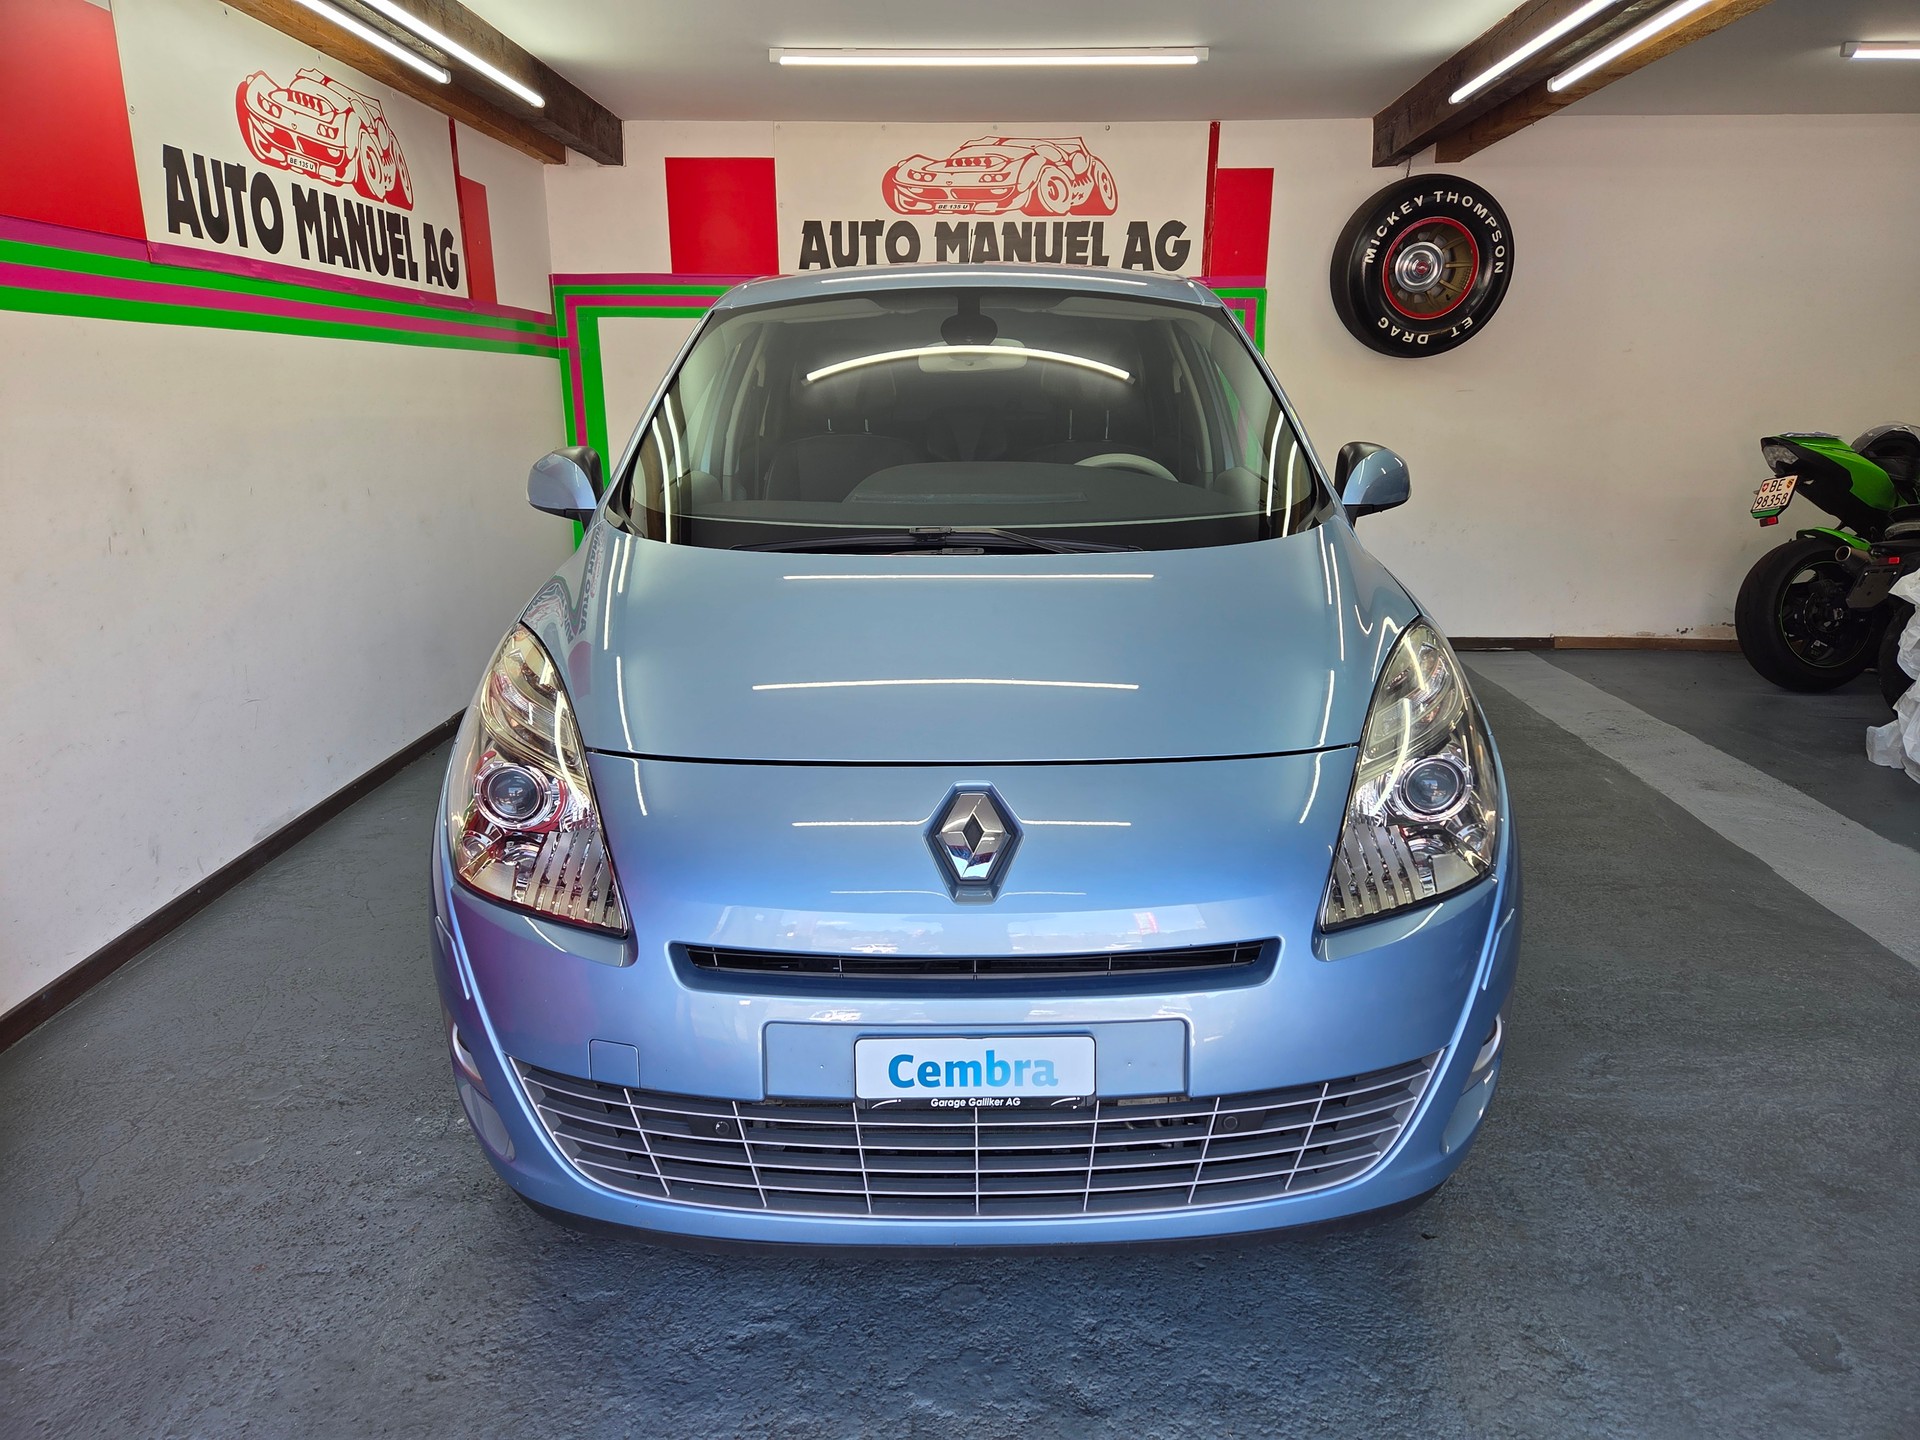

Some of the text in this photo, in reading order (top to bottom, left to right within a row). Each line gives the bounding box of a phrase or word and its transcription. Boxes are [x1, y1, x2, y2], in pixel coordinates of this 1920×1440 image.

[162, 144, 460, 290] AUTO MANUEL AG
[1364, 190, 1505, 274] MICKEY THOMPSON
[799, 219, 1191, 271] AUTO MANUEL AG
[1378, 317, 1429, 344] DRAG
[1755, 493, 1788, 508] 98358
[1769, 479, 1786, 492] BE
[888, 1050, 1058, 1088] Cembra
[930, 1097, 1021, 1109] Garage Galliker AG
